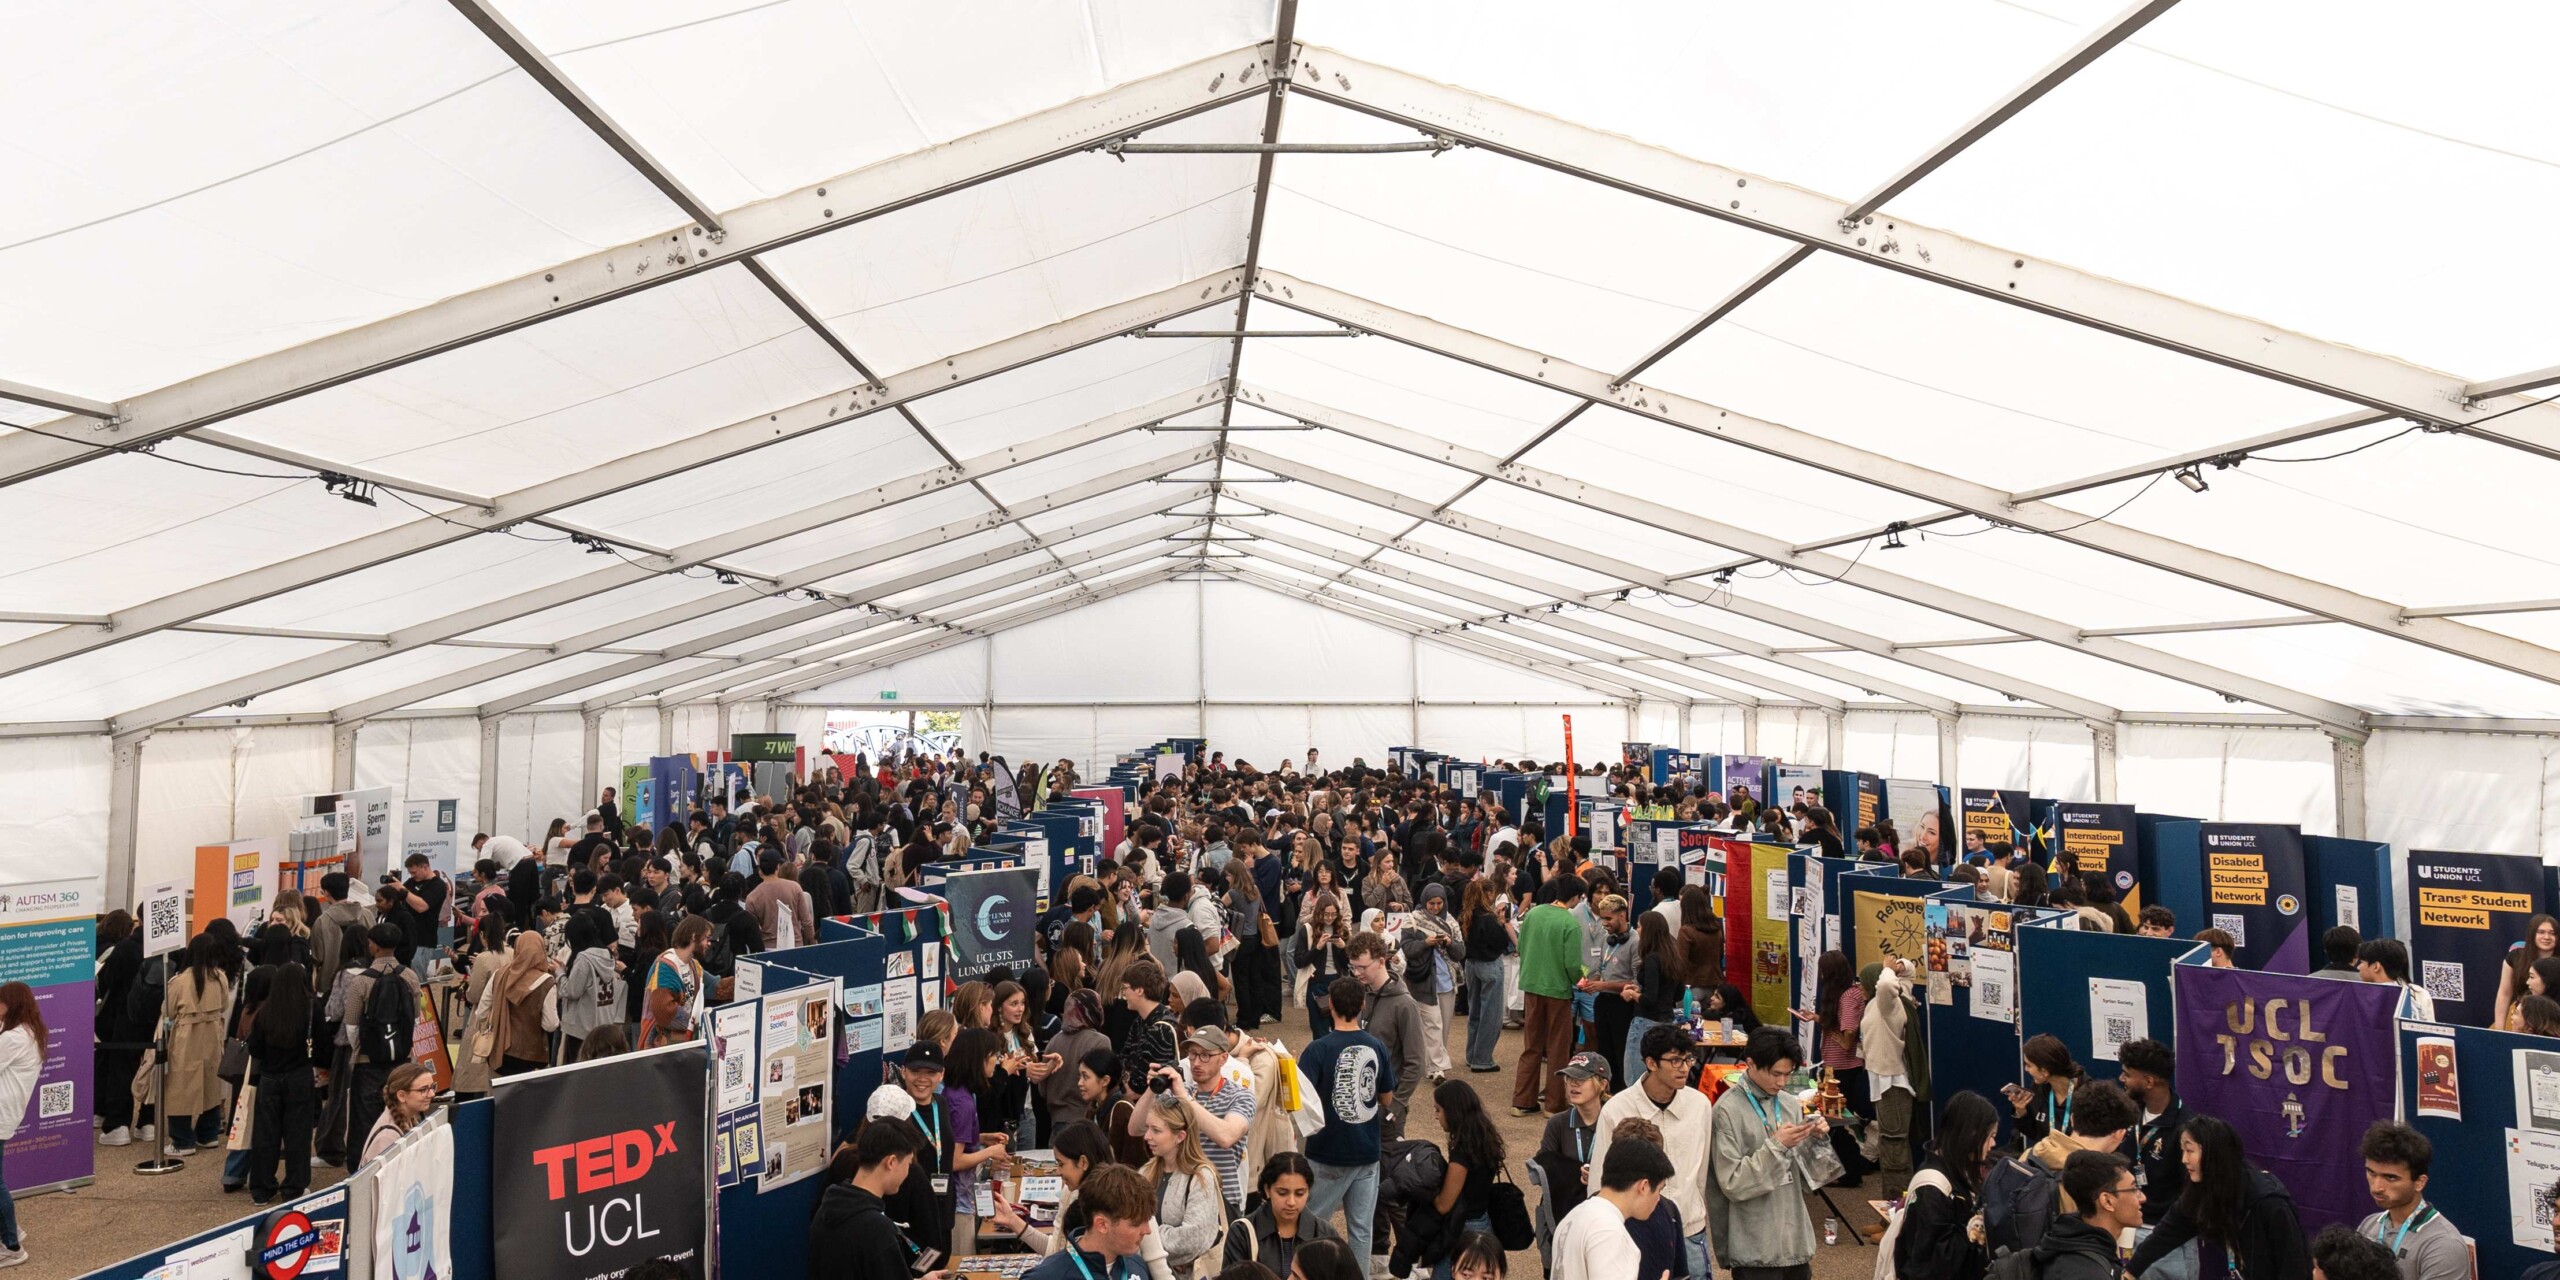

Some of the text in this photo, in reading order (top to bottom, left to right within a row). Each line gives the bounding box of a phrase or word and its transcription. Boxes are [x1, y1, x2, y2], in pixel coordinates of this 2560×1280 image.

[1727, 776, 1750, 784] ACTIVE
[367, 813, 386, 825] Sperm
[366, 826, 381, 837] Bank
[2067, 832, 2120, 841] International
[2079, 861, 2104, 869] twork
[2213, 857, 2259, 867] Disabled
[2433, 866, 2482, 874] STUDENTS'
[2214, 874, 2265, 884] Students'
[16, 892, 79, 906] AUTISM 360
[2215, 891, 2261, 902] Network
[2471, 895, 2527, 908] Student
[1876, 900, 1925, 924] Refuge
[2424, 912, 2485, 925] Network
[30, 927, 66, 937] improving
[6, 946, 33, 954] specialist
[57, 954, 91, 962] organisation
[976, 951, 1013, 963] UCL STS
[5, 967, 24, 975] clinical
[25, 965, 47, 973] experts
[958, 964, 990, 977] LUNAR
[770, 1010, 794, 1022] Taiwanese
[2227, 996, 2326, 1042] UCL
[770, 1021, 787, 1030] Society
[2217, 1034, 2349, 1090] TSOC
[2531, 1141, 2555, 1149] welcome
[533, 1120, 678, 1200] TEDx
[2527, 1160, 2548, 1170] Telugu
[565, 1193, 660, 1256] UCL
[263, 1233, 314, 1260] MIND THE GAP
[191, 1253, 216, 1266] welcome
[673, 1248, 694, 1261] event
